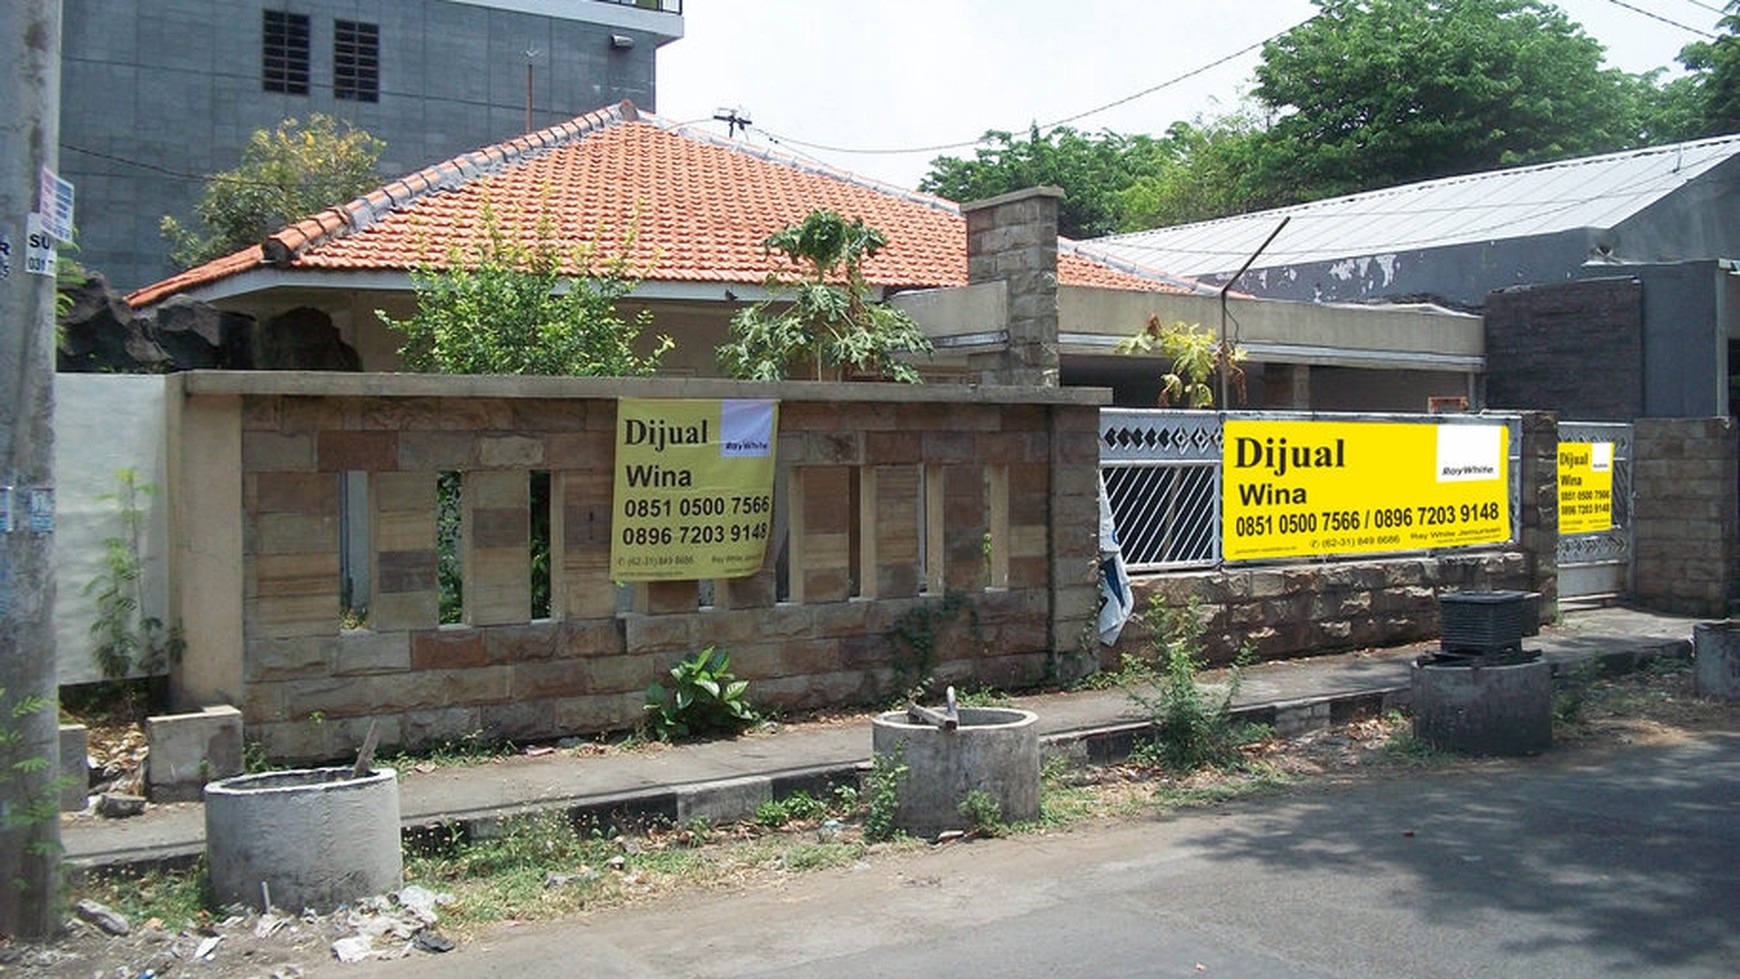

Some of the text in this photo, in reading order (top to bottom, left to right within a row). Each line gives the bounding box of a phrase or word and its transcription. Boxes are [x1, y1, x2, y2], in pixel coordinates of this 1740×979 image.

[624, 419, 707, 452] Dijual
[1234, 437, 1345, 477] Dijual
[1560, 452, 1588, 469] Dijual
[626, 465, 692, 488] Wina
[1442, 465, 1494, 476] RayWhite
[1561, 474, 1582, 486] Wina
[1238, 483, 1307, 506] Wina
[624, 496, 770, 517] 0851 0500 7566
[1236, 502, 1499, 537] 0851 0500 7566 / 0896 7203 9148
[622, 523, 768, 545] 0896 7203 9148
